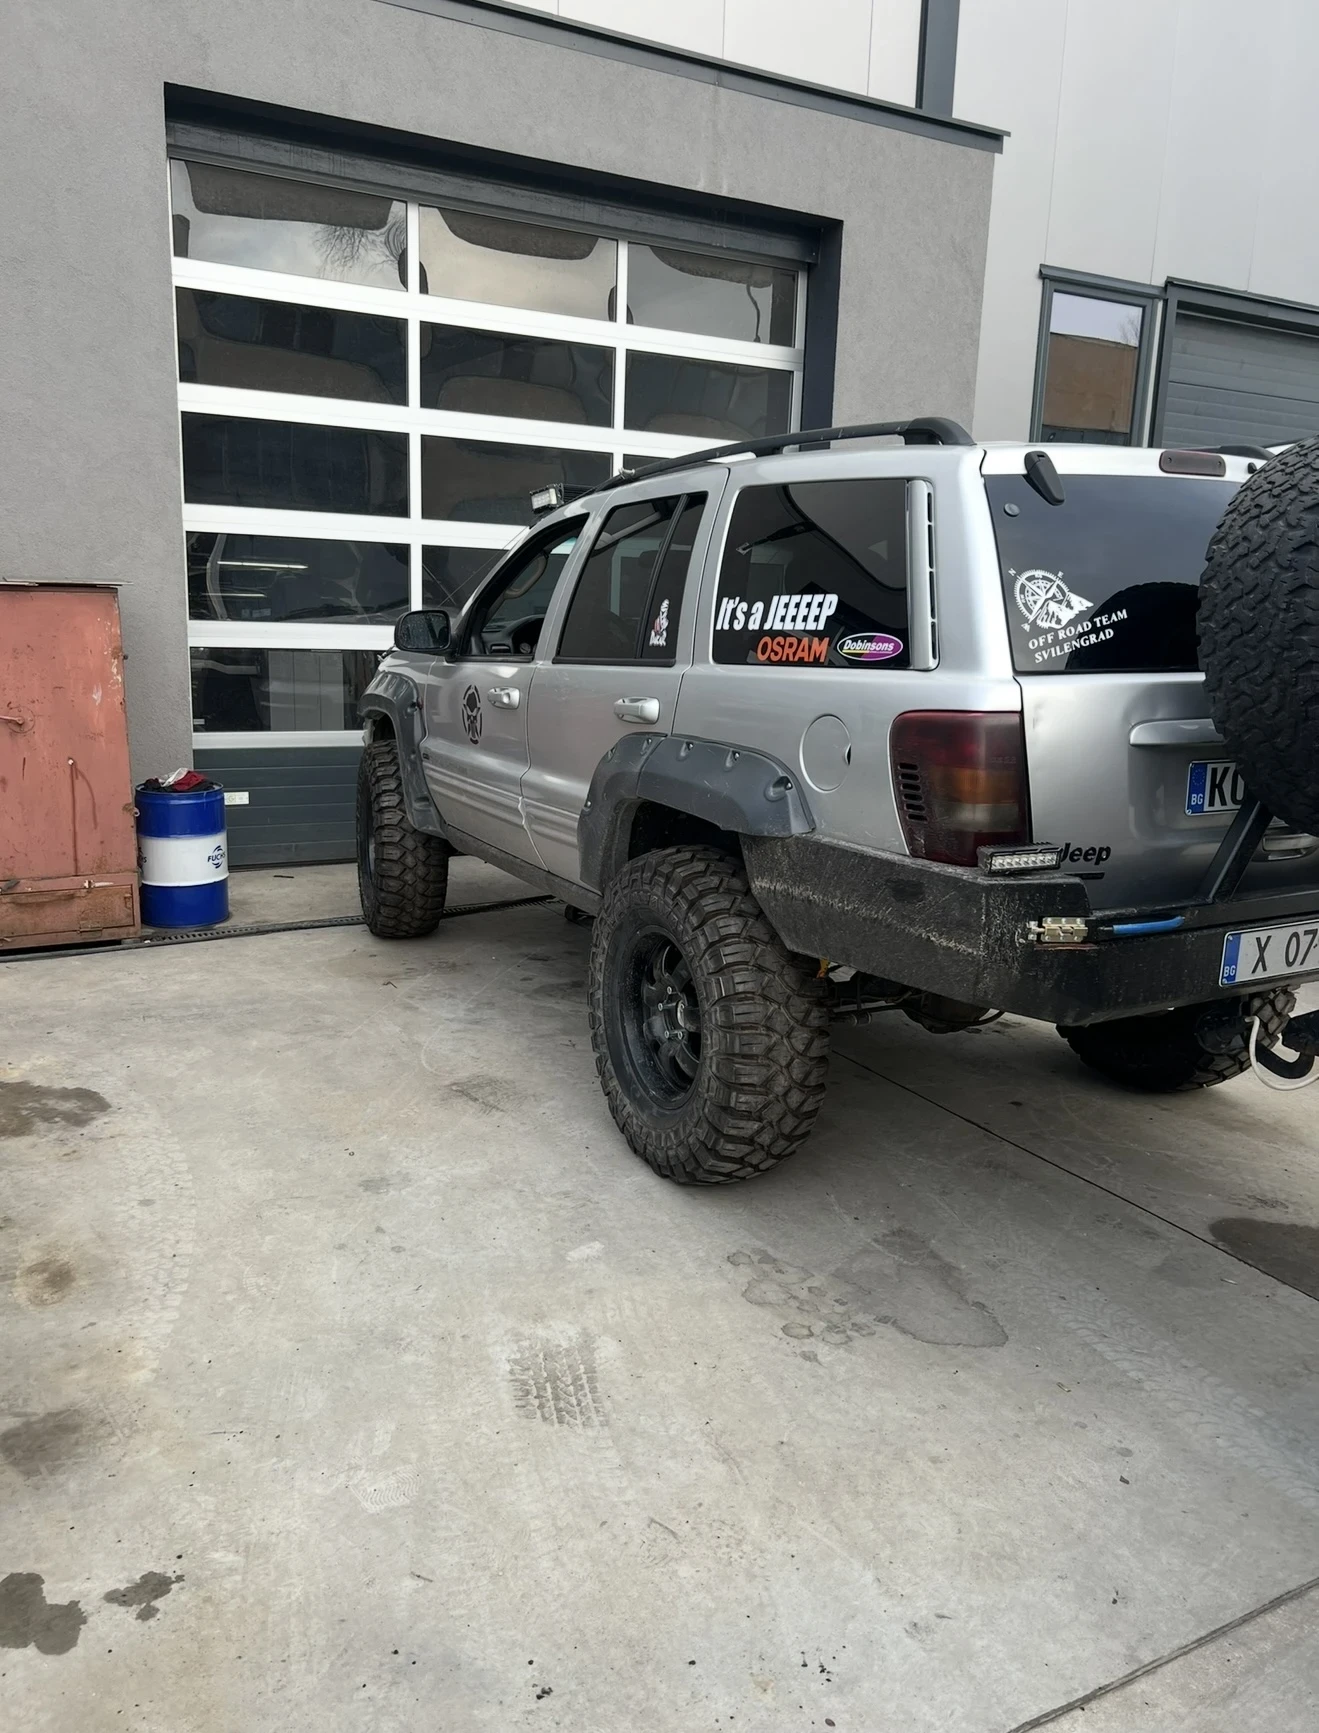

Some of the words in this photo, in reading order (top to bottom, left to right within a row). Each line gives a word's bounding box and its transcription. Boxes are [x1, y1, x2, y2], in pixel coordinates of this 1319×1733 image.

[715, 597, 748, 630] It's
[748, 601, 765, 630] a
[763, 594, 839, 631] JEEEEP
[1028, 632, 1055, 650] OFF
[1057, 621, 1092, 640] ROAD
[1094, 609, 1128, 628] TEAM
[756, 636, 830, 663] OSRAM
[843, 640, 895, 651] Dobinsons
[1034, 628, 1114, 663] SVILENGRAD
[1191, 793, 1204, 805] BG
[1059, 842, 1111, 865] Jeep
[1251, 935, 1272, 974] X
[1223, 965, 1236, 977] BG
